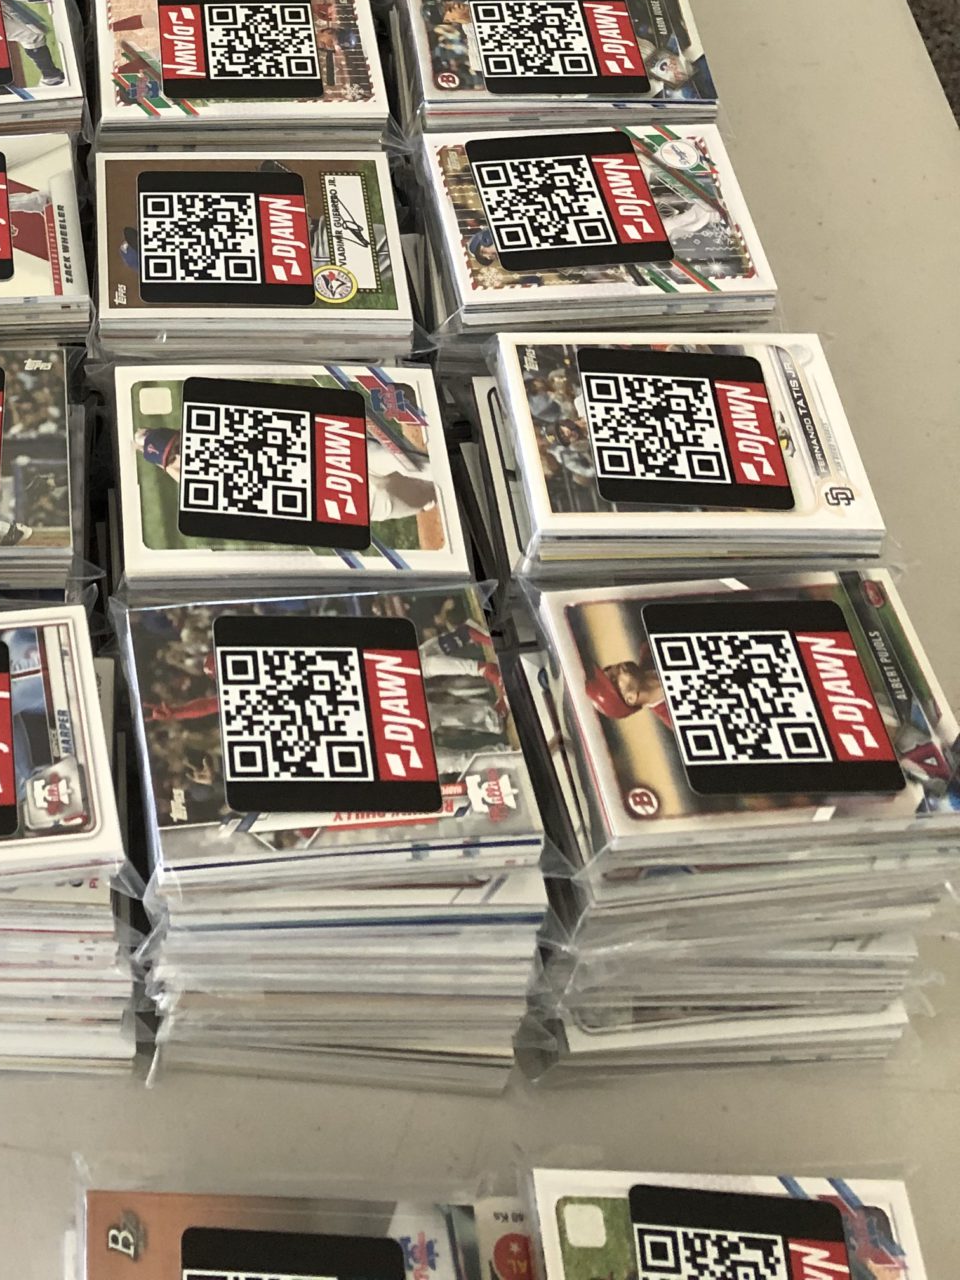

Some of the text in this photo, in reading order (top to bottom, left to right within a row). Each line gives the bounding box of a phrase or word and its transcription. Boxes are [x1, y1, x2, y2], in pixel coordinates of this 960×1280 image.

[57, 205, 69, 253] WHEELER
[334, 230, 347, 267] VLADIMIR
[789, 379, 808, 415] TATIS
[803, 418, 827, 473] FERNANDO
[869, 631, 908, 701] ALBERT PUJOLS
[57, 709, 73, 754] HARPER
